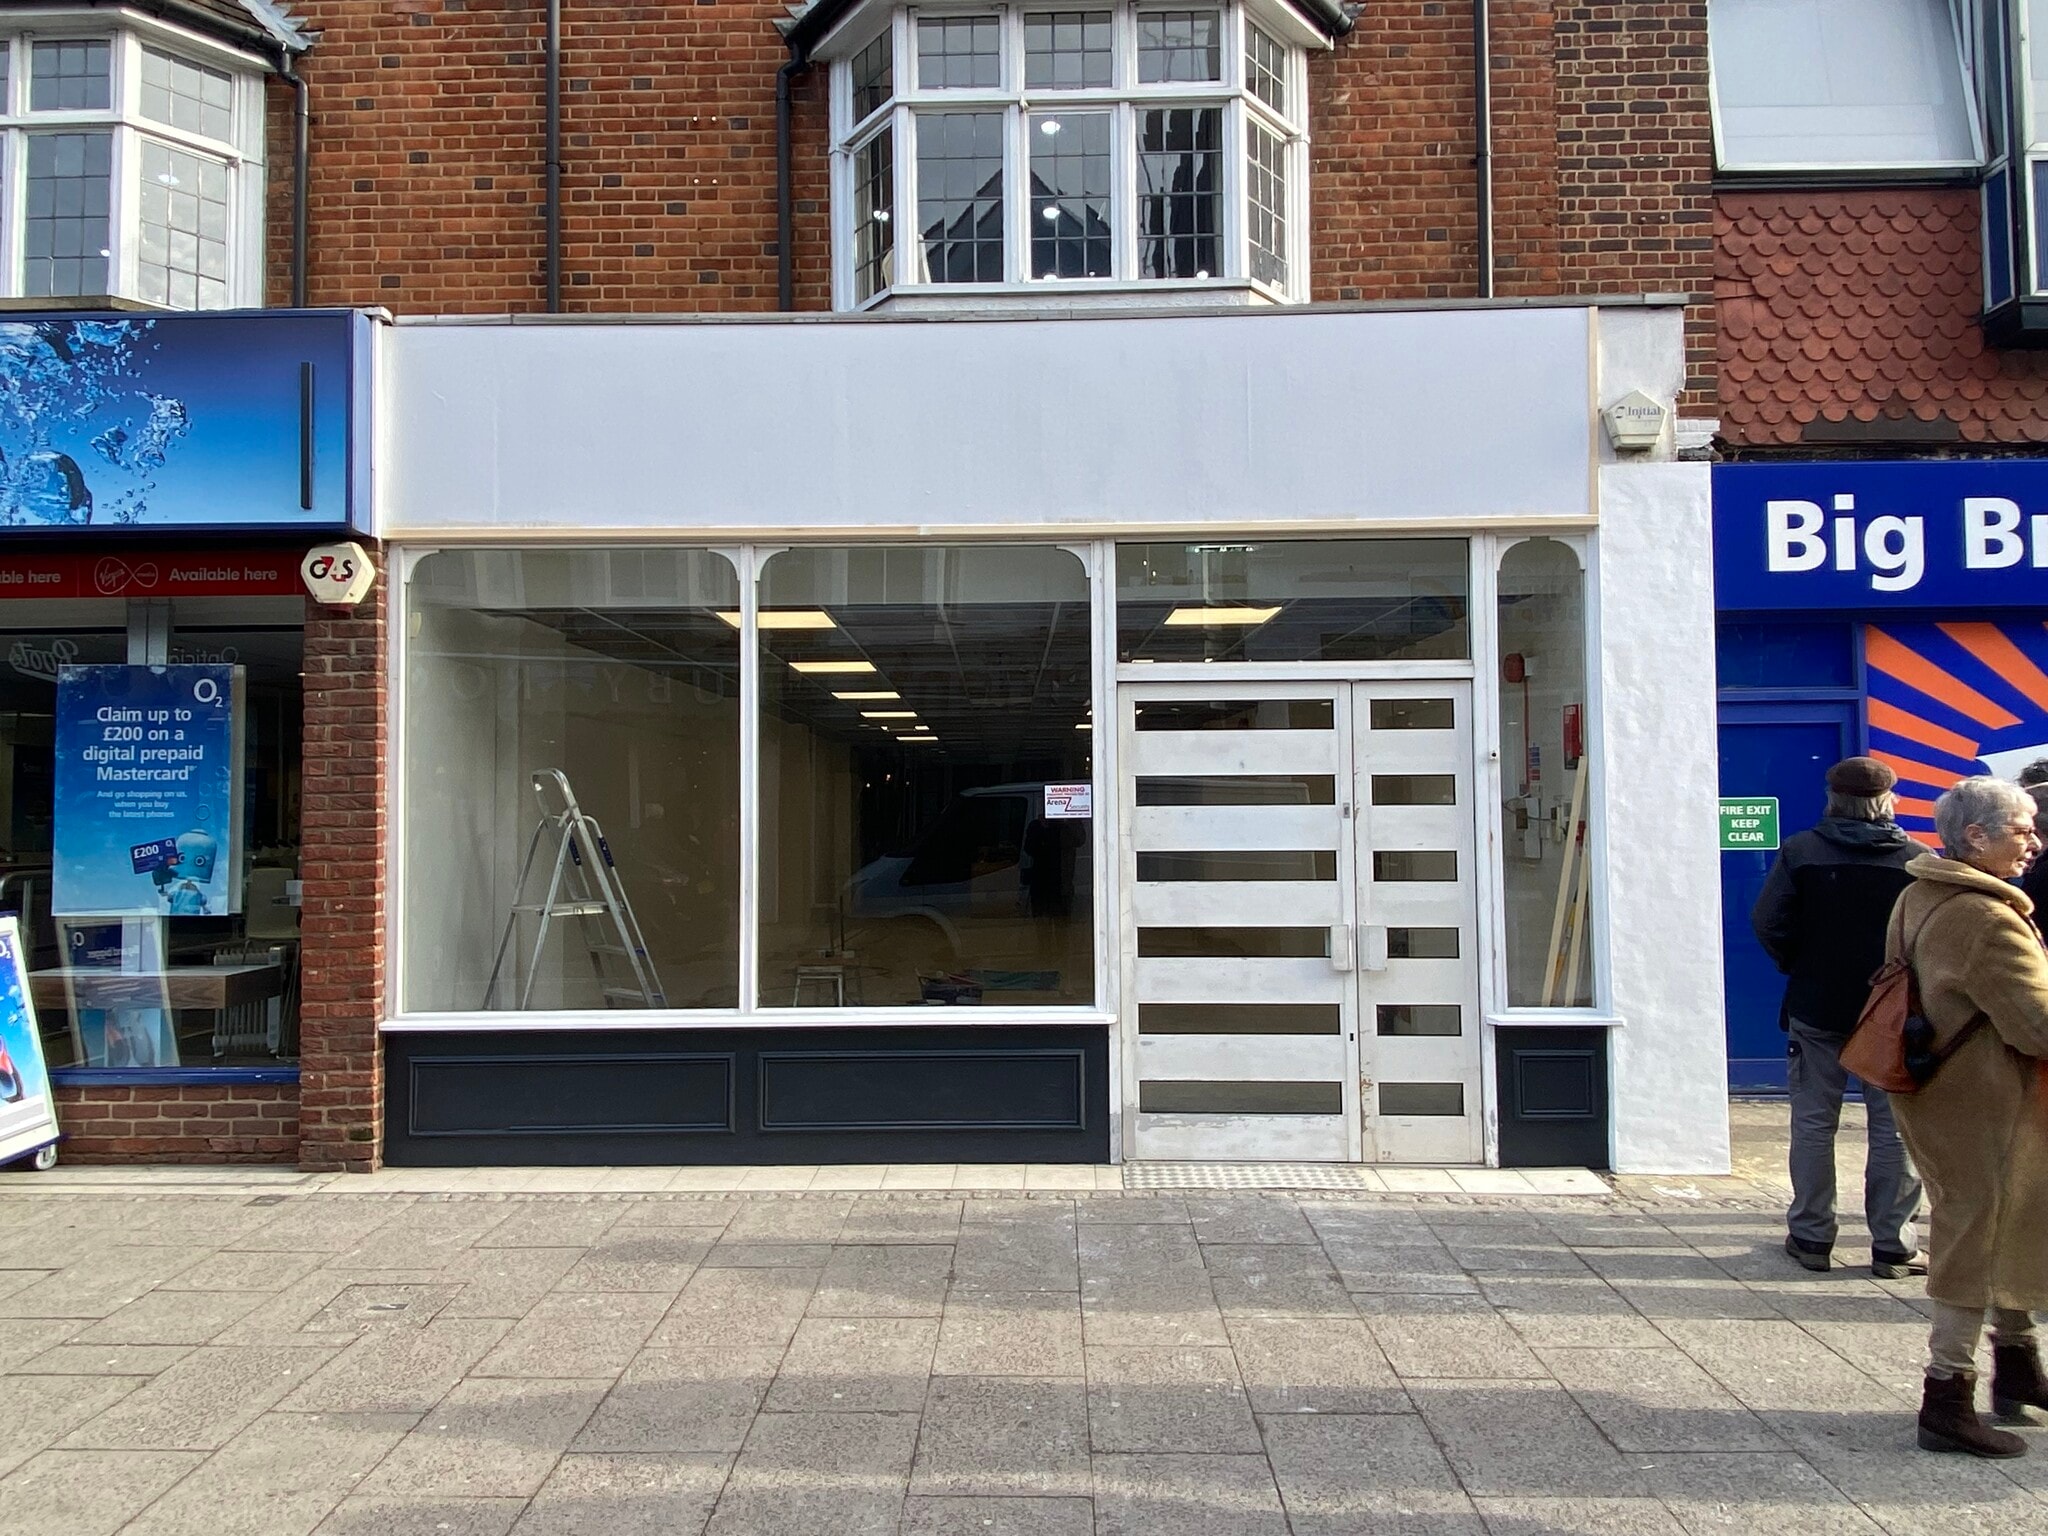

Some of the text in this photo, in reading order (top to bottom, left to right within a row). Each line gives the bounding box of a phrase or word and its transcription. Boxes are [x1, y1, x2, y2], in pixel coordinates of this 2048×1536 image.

[1628, 406, 1660, 416] Initial
[1767, 493, 1925, 592] Big
[169, 567, 277, 581] Available here
[310, 556, 353, 582] G4S
[28, 570, 61, 583] here
[97, 707, 192, 725] Claim up to
[103, 726, 184, 741] £200 on a
[83, 744, 203, 764] digital prepaid
[1720, 805, 1771, 815] FIRE EXIT
[1731, 819, 1760, 829] KEEP
[1728, 832, 1764, 842] CLEAR
[134, 844, 159, 859] £200
